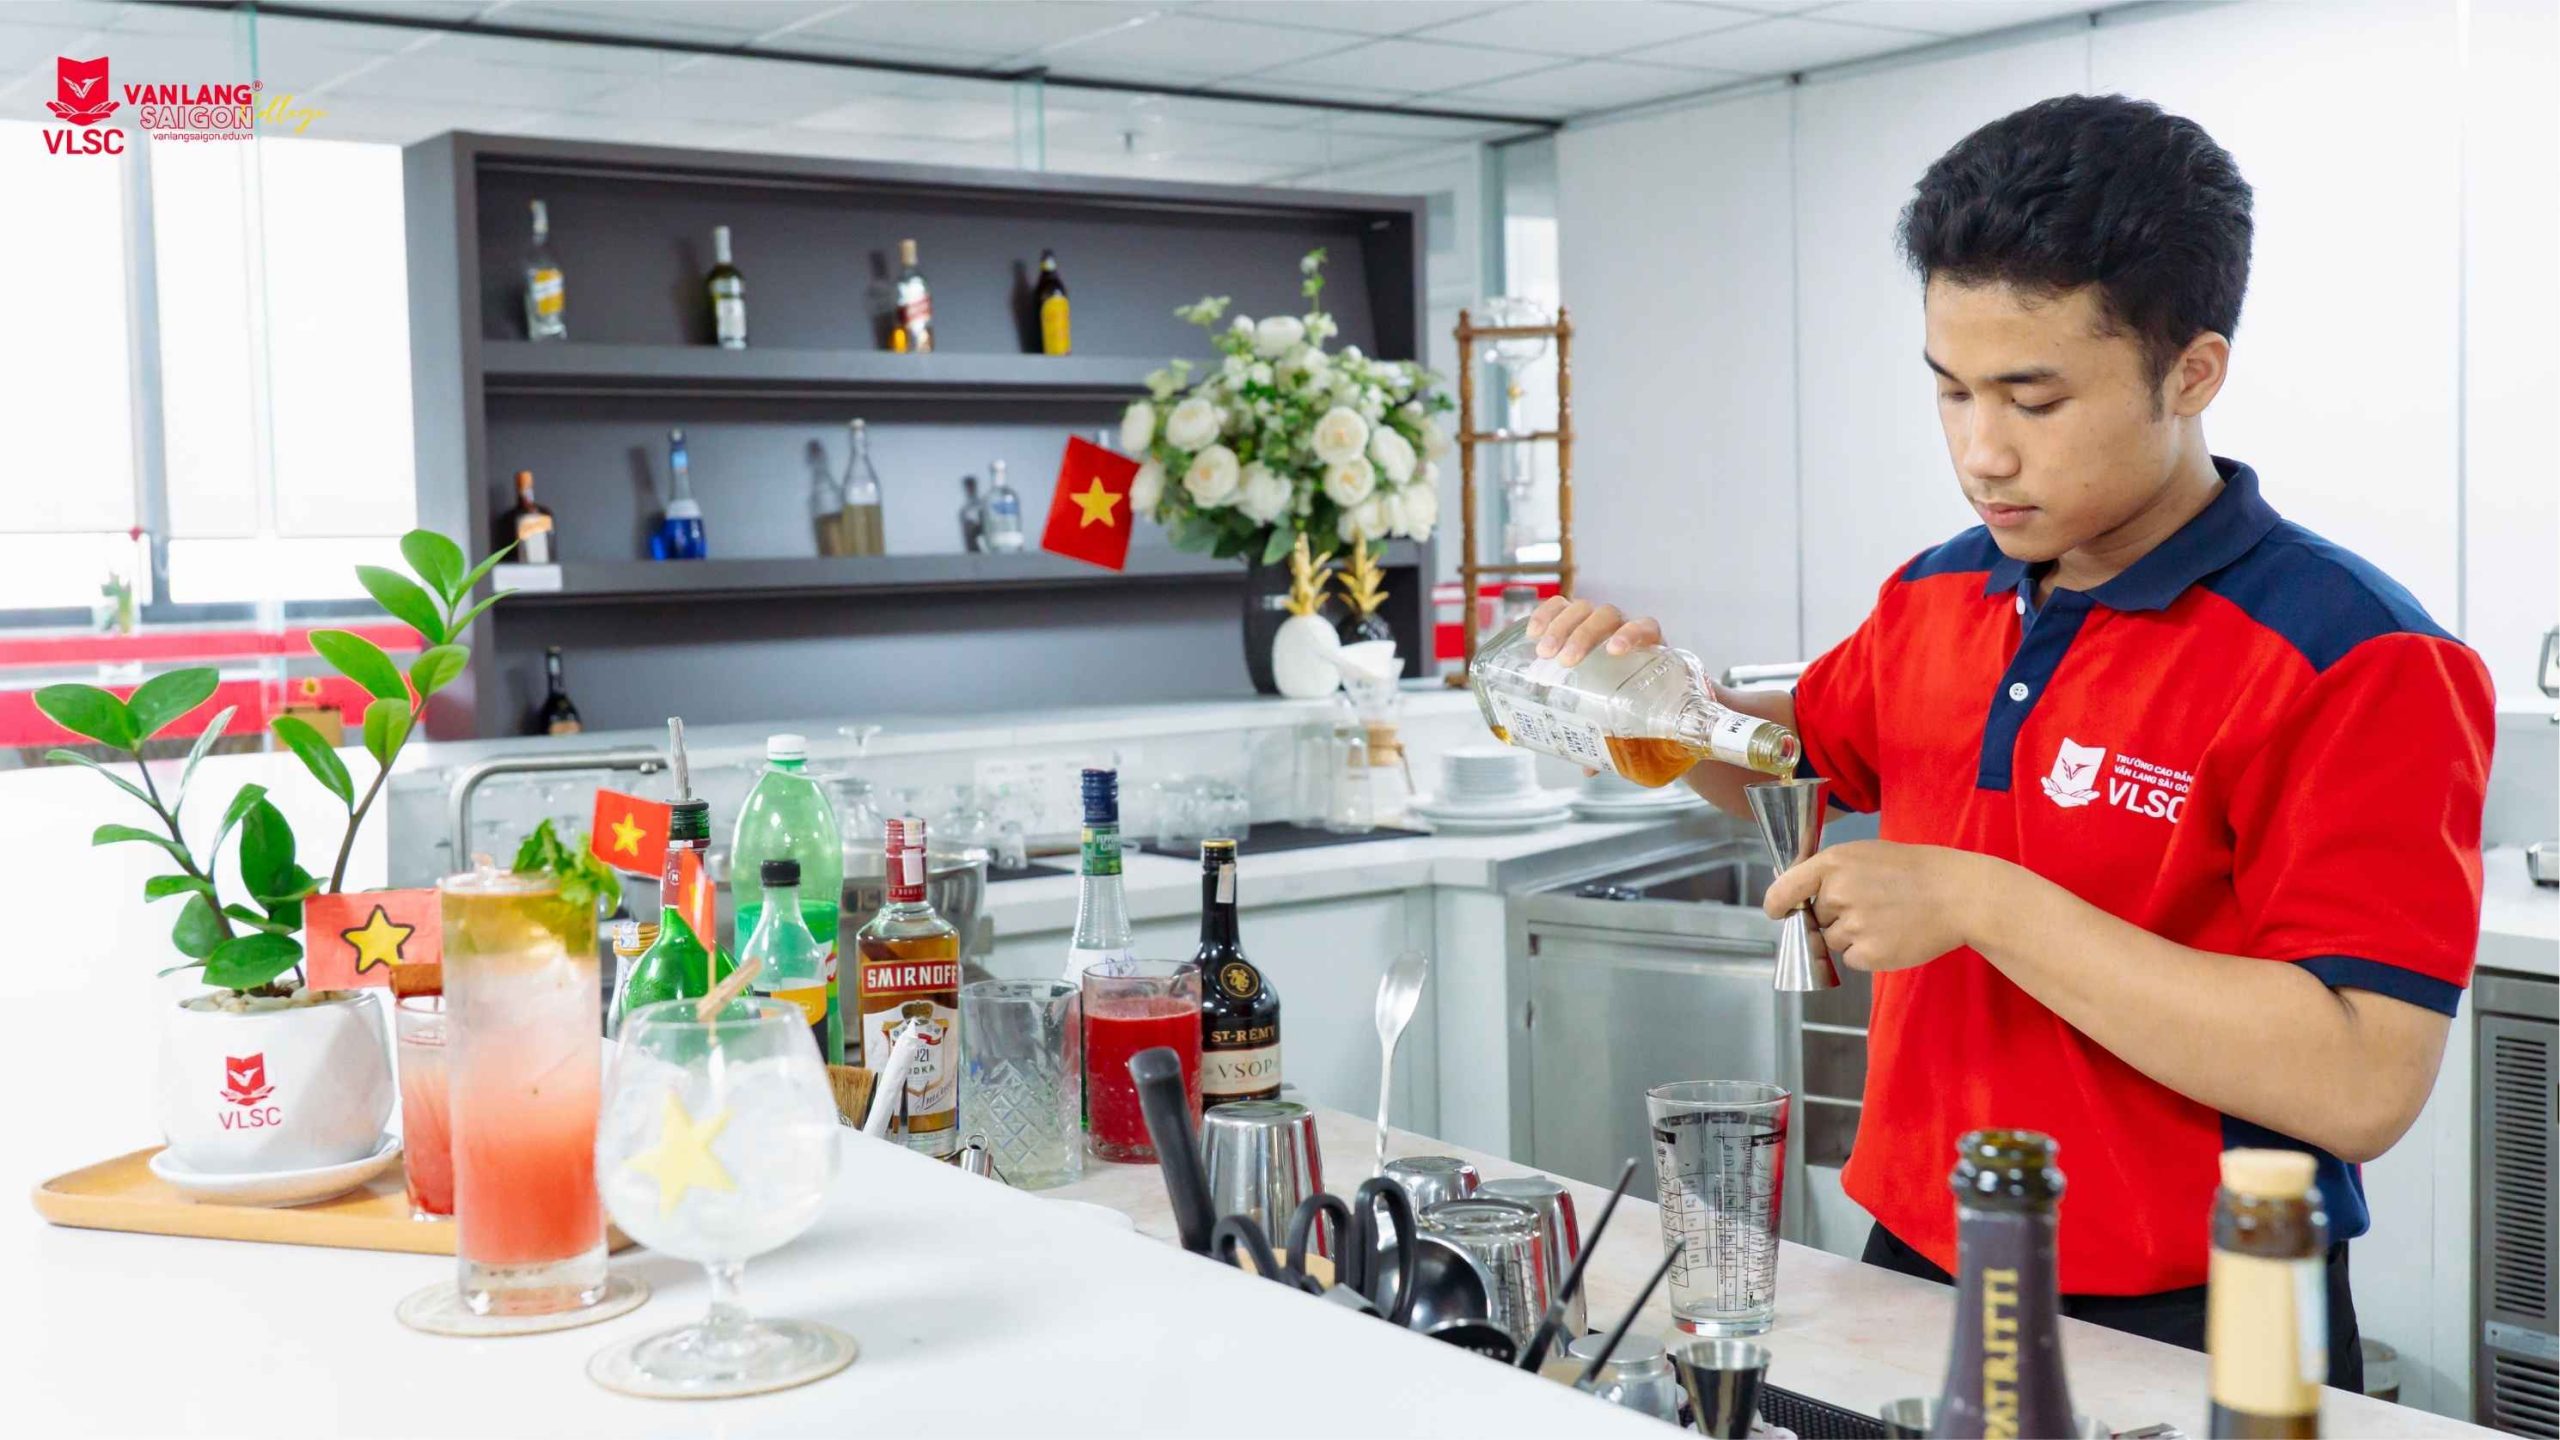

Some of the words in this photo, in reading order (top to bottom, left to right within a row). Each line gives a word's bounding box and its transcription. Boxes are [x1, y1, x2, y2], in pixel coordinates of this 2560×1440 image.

[2132, 770, 2157, 784] LANG
[2174, 783, 2189, 794] GÒ
[867, 963, 957, 989] SMIRNOFF
[1218, 1057, 1273, 1080] VSOP
[219, 1106, 282, 1130] VLSC
